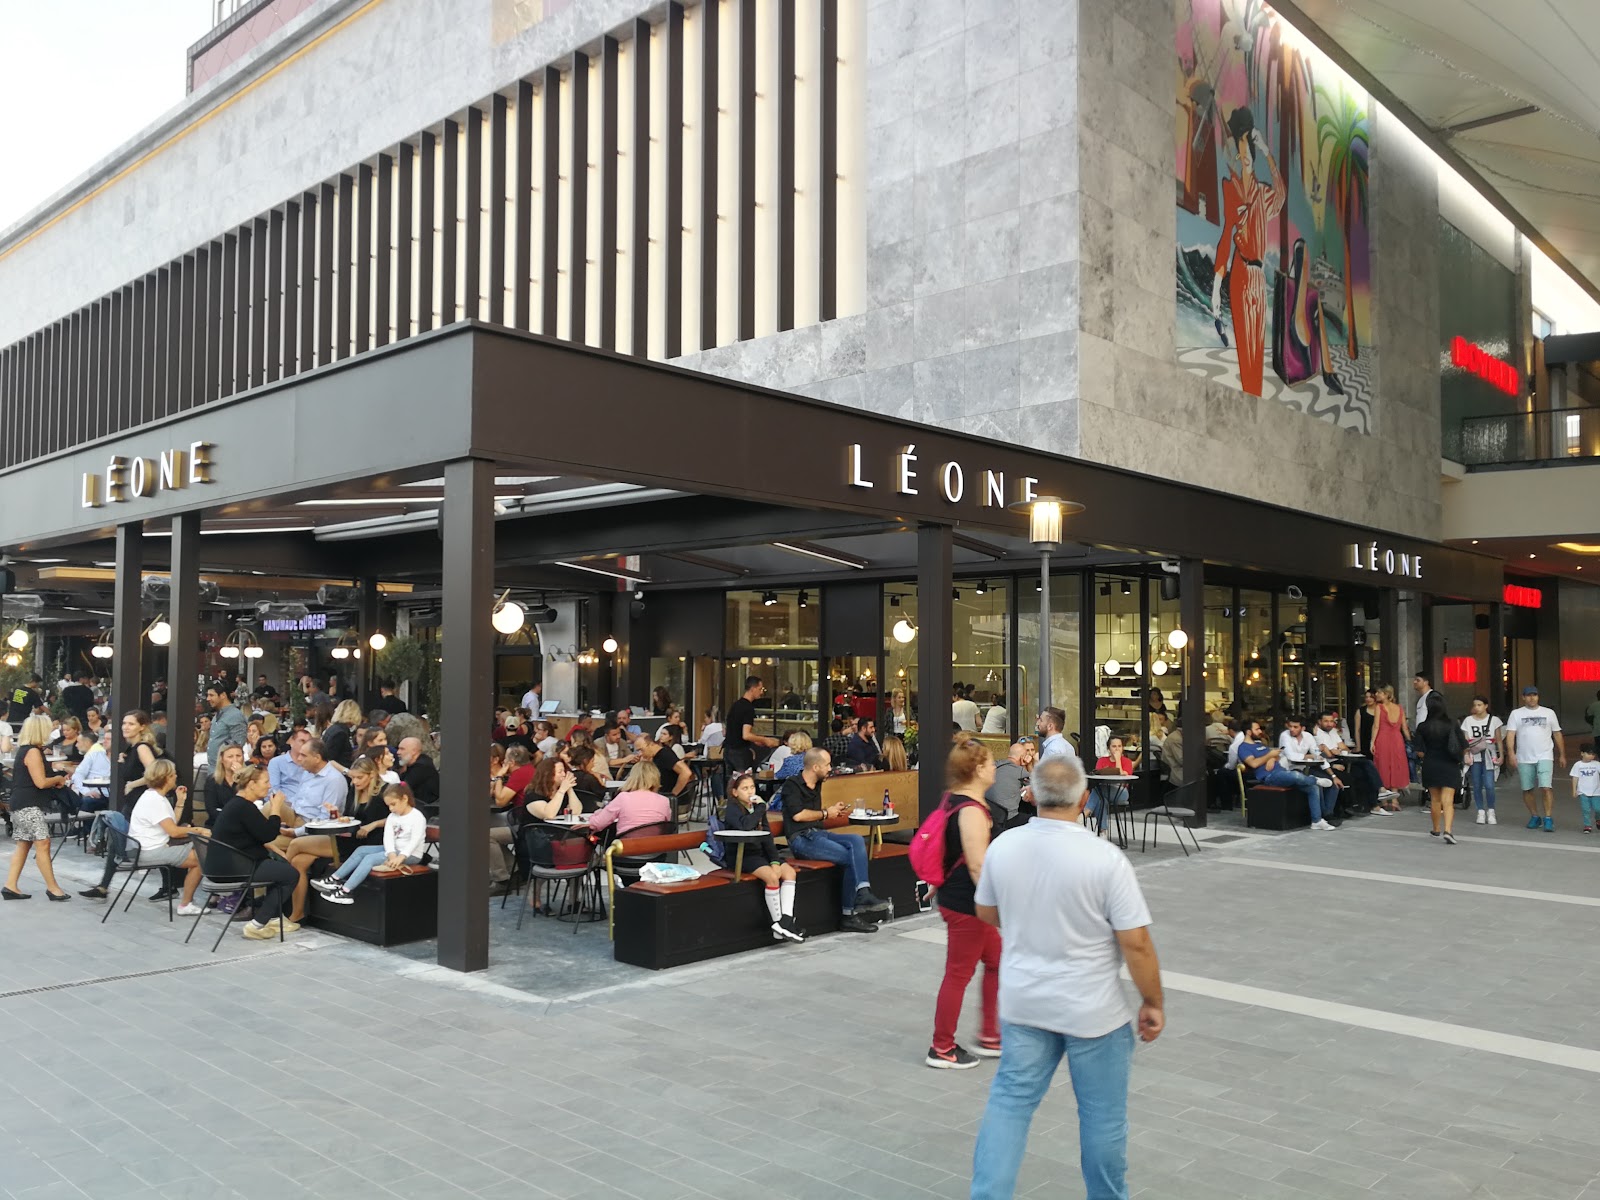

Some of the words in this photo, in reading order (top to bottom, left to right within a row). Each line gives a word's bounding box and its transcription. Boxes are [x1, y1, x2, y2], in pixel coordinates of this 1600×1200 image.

[82, 440, 209, 508] LÉONE
[1352, 541, 1422, 578] LÉONE
[298, 613, 326, 631] BURGER
